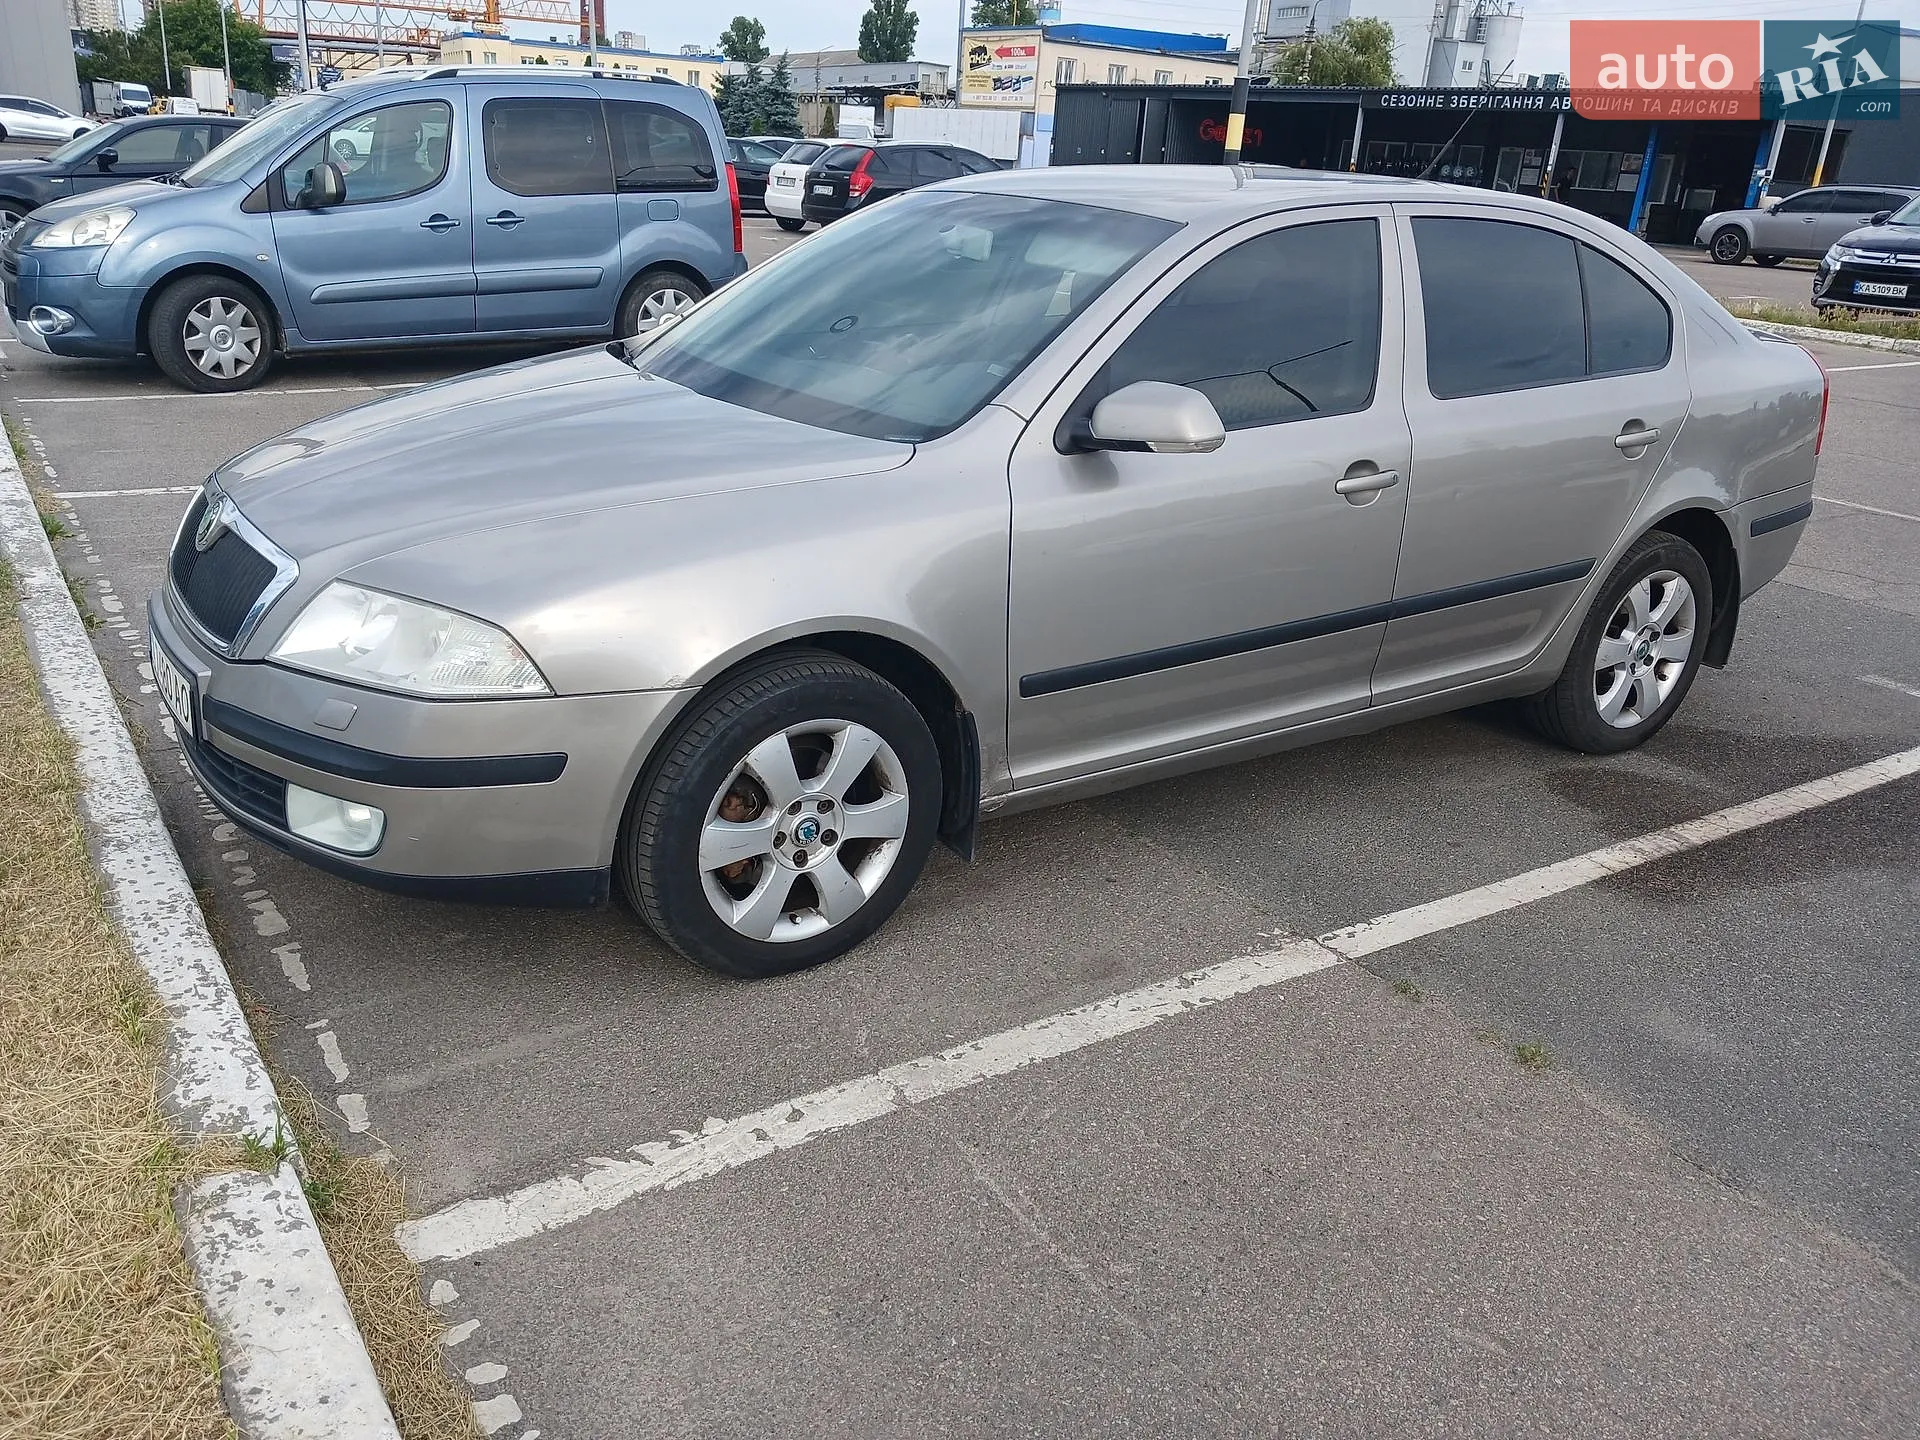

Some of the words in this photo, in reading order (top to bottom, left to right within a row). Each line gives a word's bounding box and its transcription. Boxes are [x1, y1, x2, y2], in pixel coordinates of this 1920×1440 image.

[1381, 94, 1445, 108] СЕЗОННЕ
[1450, 95, 1544, 110] ЗБЕРІГАННЯ
[1549, 96, 1635, 112] АВТОШИН
[1642, 98, 1662, 113] ТА
[1668, 99, 1739, 115] ДИСКІВ
[1872, 285, 1891, 295] 5109
